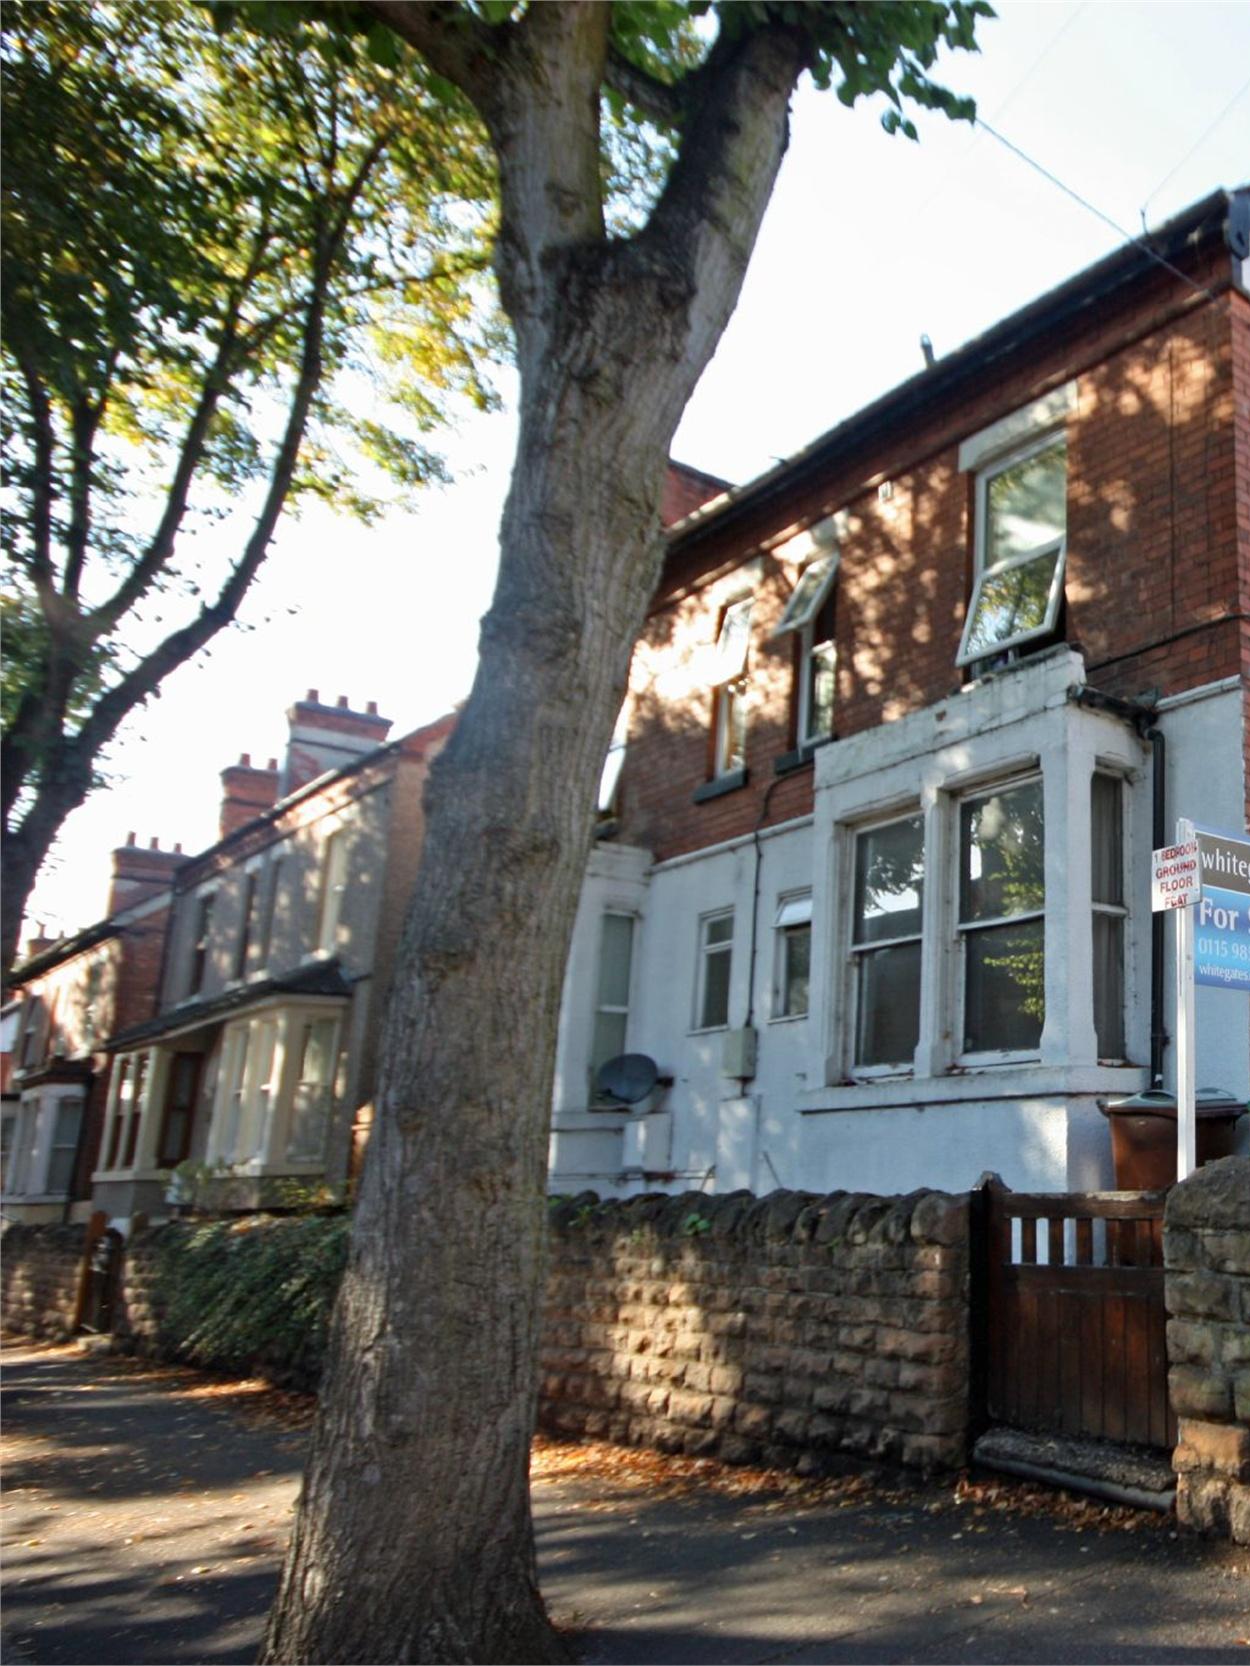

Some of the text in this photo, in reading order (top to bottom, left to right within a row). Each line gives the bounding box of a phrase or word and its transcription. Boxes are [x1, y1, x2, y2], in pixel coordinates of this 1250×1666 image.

[1155, 859, 1197, 879] GROUND
[1160, 876, 1193, 893] FLOOR
[1165, 893, 1188, 908] FLAT
[1200, 898, 1239, 930] For
[1199, 938, 1227, 956] 0115
